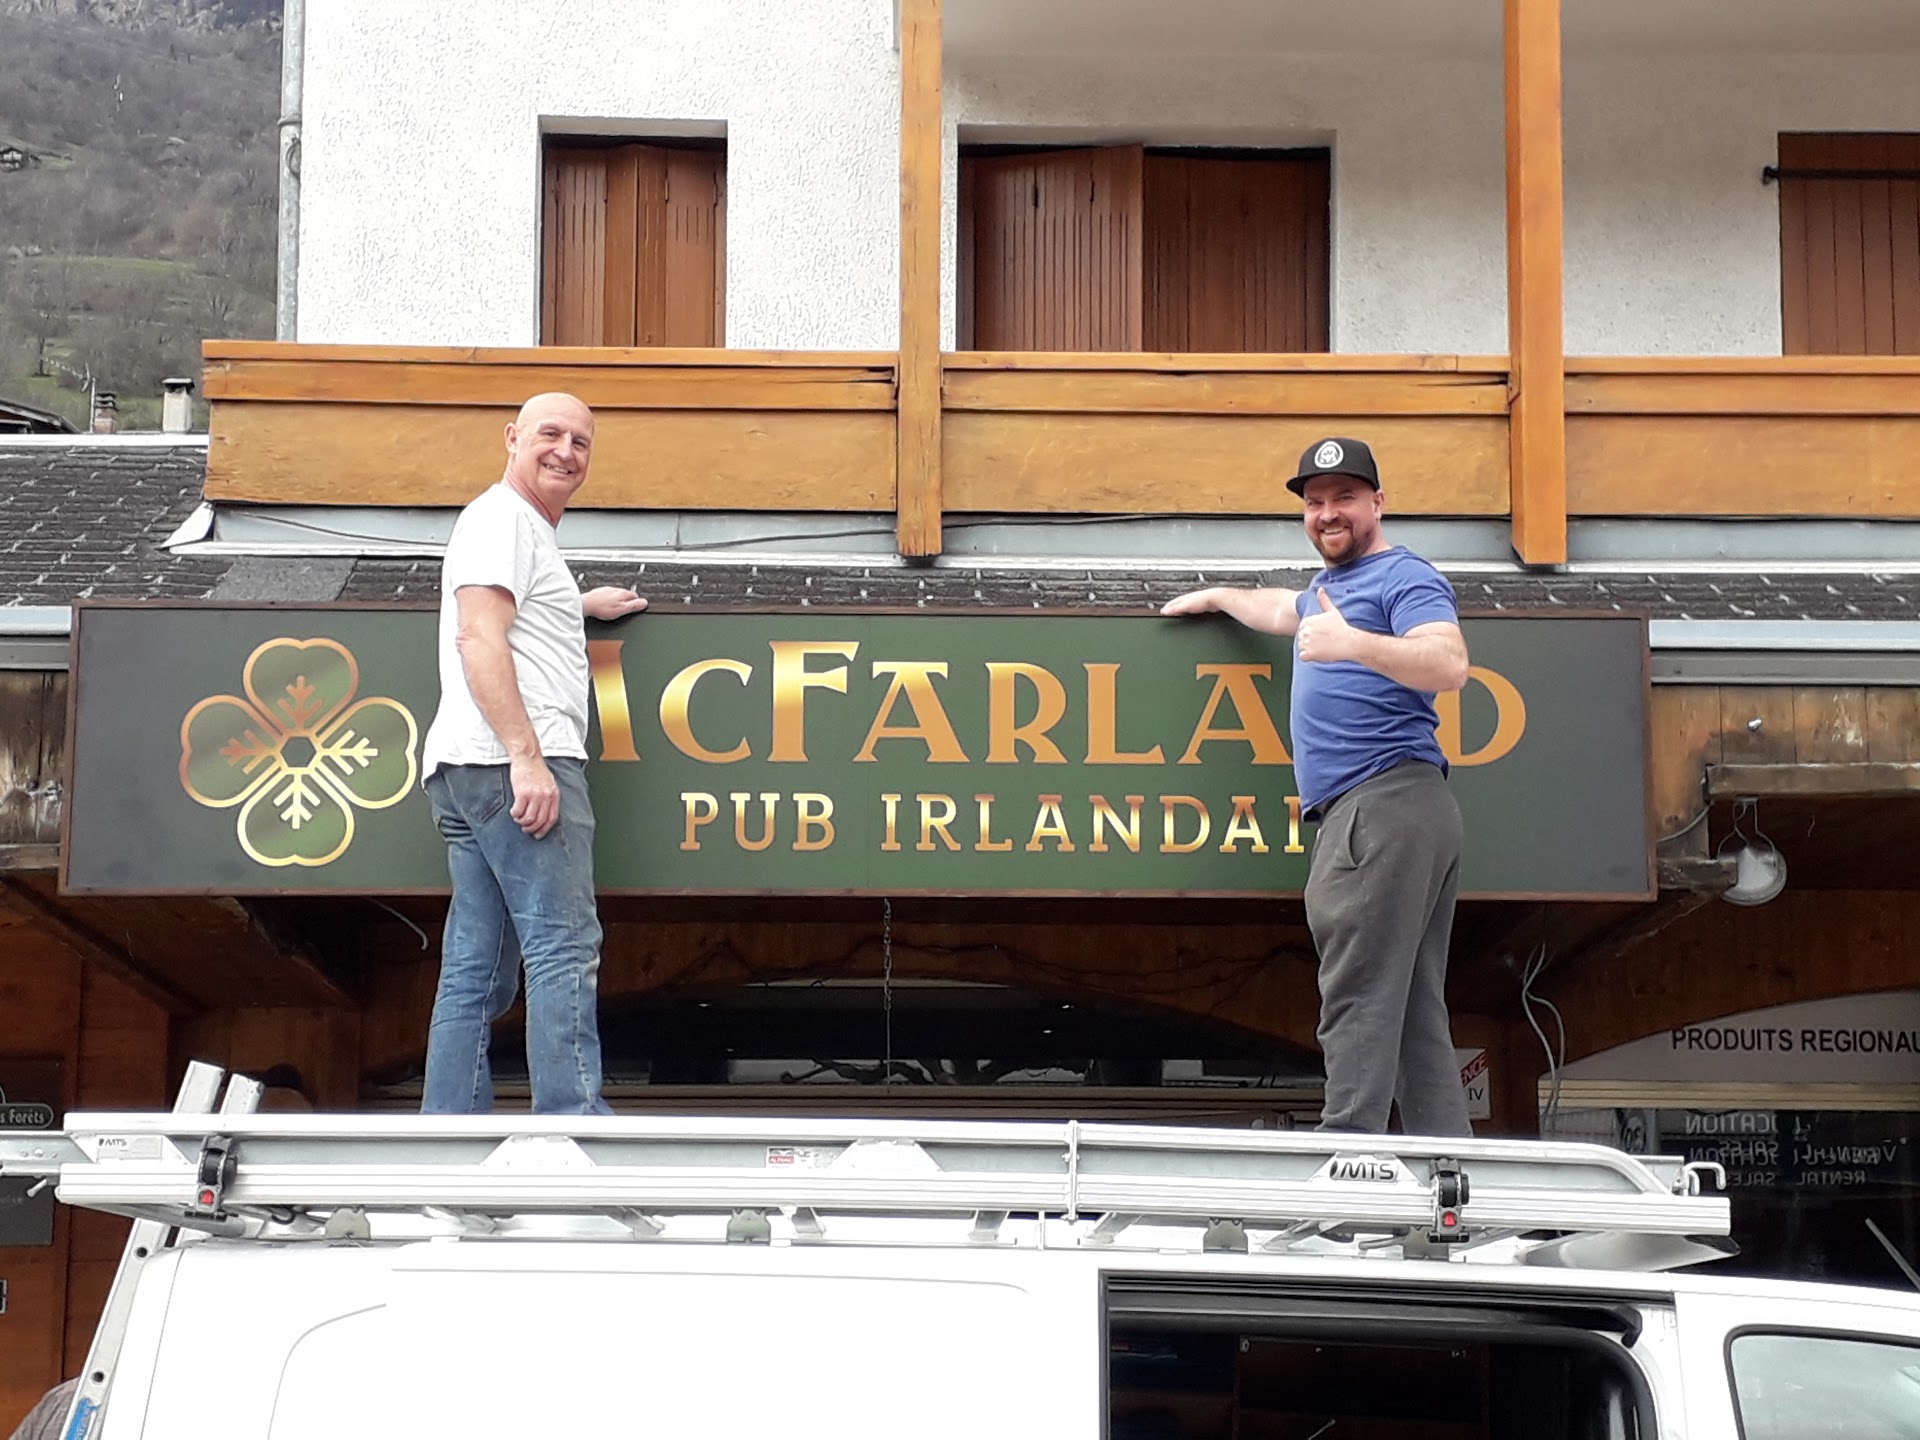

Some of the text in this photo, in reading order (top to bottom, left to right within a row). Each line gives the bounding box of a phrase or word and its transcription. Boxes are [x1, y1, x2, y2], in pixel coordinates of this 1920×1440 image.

[680, 791, 1321, 854] PUB IRLANDAI
[1672, 1028, 1793, 1051] PRODUITS
[1340, 1161, 1395, 1180] MTS
